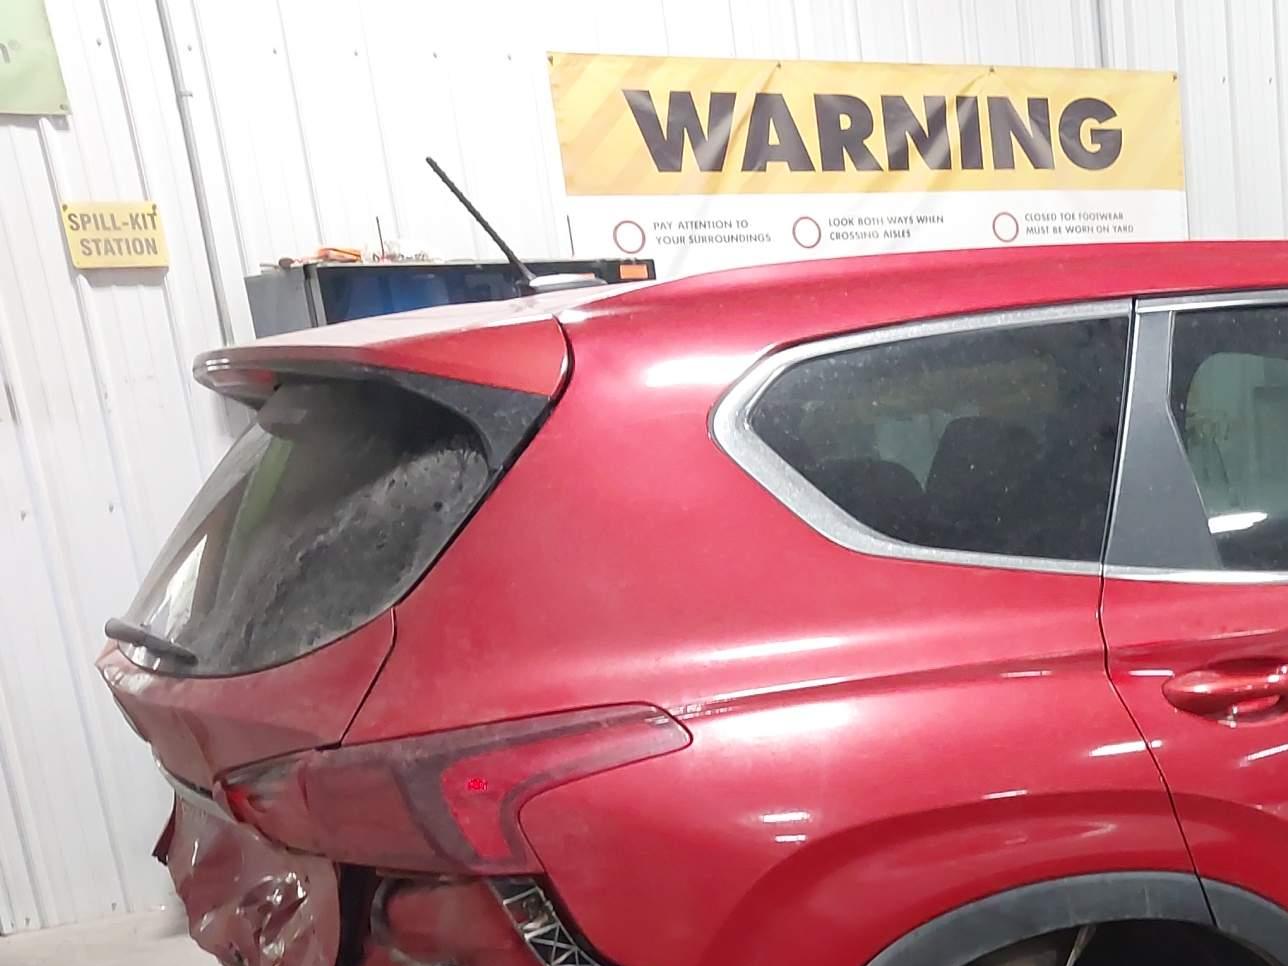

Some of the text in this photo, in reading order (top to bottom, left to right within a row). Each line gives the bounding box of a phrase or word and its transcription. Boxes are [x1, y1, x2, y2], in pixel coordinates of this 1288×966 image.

[622, 89, 1124, 172] WARNING
[67, 211, 158, 231] SPILL-KIT
[828, 215, 944, 227] LOOK BOTH WAYS WHEN
[1025, 211, 1124, 221] CLOSED TOE FOOTWEAR
[653, 219, 749, 230] PAY ATTENTION TO
[1026, 223, 1134, 235] MUST BE WORN ON YARD
[656, 233, 772, 245] YOUR SURROUNDINGS
[829, 229, 911, 241] CROSSING AISLES
[79, 238, 158, 257] STATION
